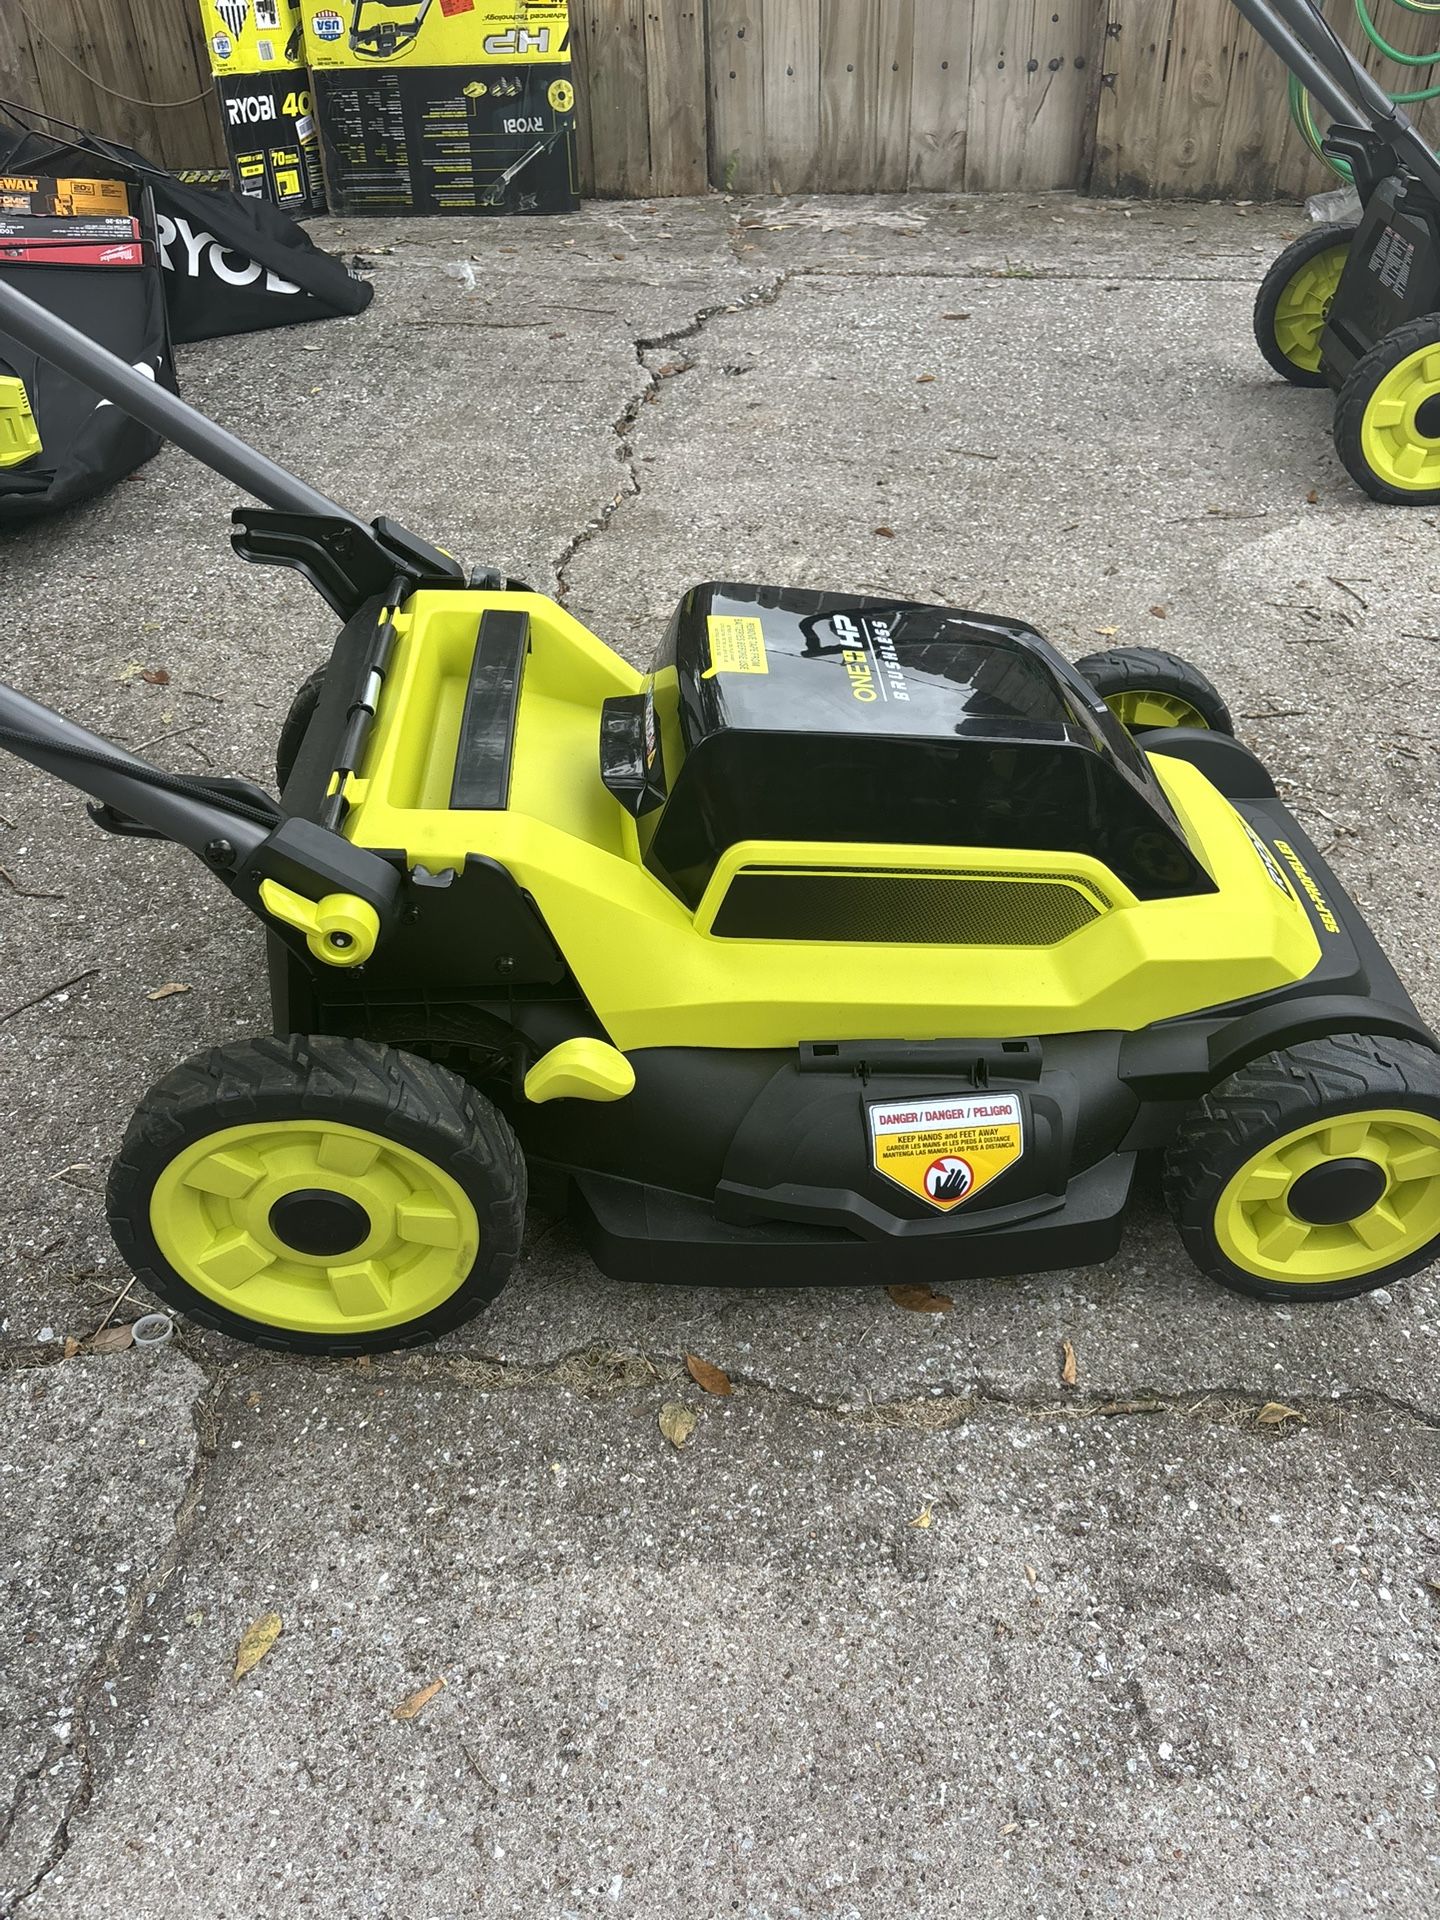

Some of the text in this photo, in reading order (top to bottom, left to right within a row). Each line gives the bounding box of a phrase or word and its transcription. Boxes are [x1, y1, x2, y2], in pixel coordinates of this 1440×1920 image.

[317, 21, 339, 30] USA
[484, 29, 549, 54] HP
[226, 95, 276, 125] RYOBI
[503, 117, 544, 133] RYOBI
[272, 151, 285, 166] 70
[156, 214, 315, 298] RYO
[833, 614, 863, 649] HP
[872, 619, 910, 702] BRUSHLESS
[1273, 840, 1341, 934] SELF-PROPELLED
[879, 1113, 918, 1125] DANGER
[925, 1109, 964, 1121] DANGER
[974, 1105, 1012, 1117] PELIGRO
[960, 1130, 976, 1138] FEET
[979, 1129, 999, 1137] AWAY
